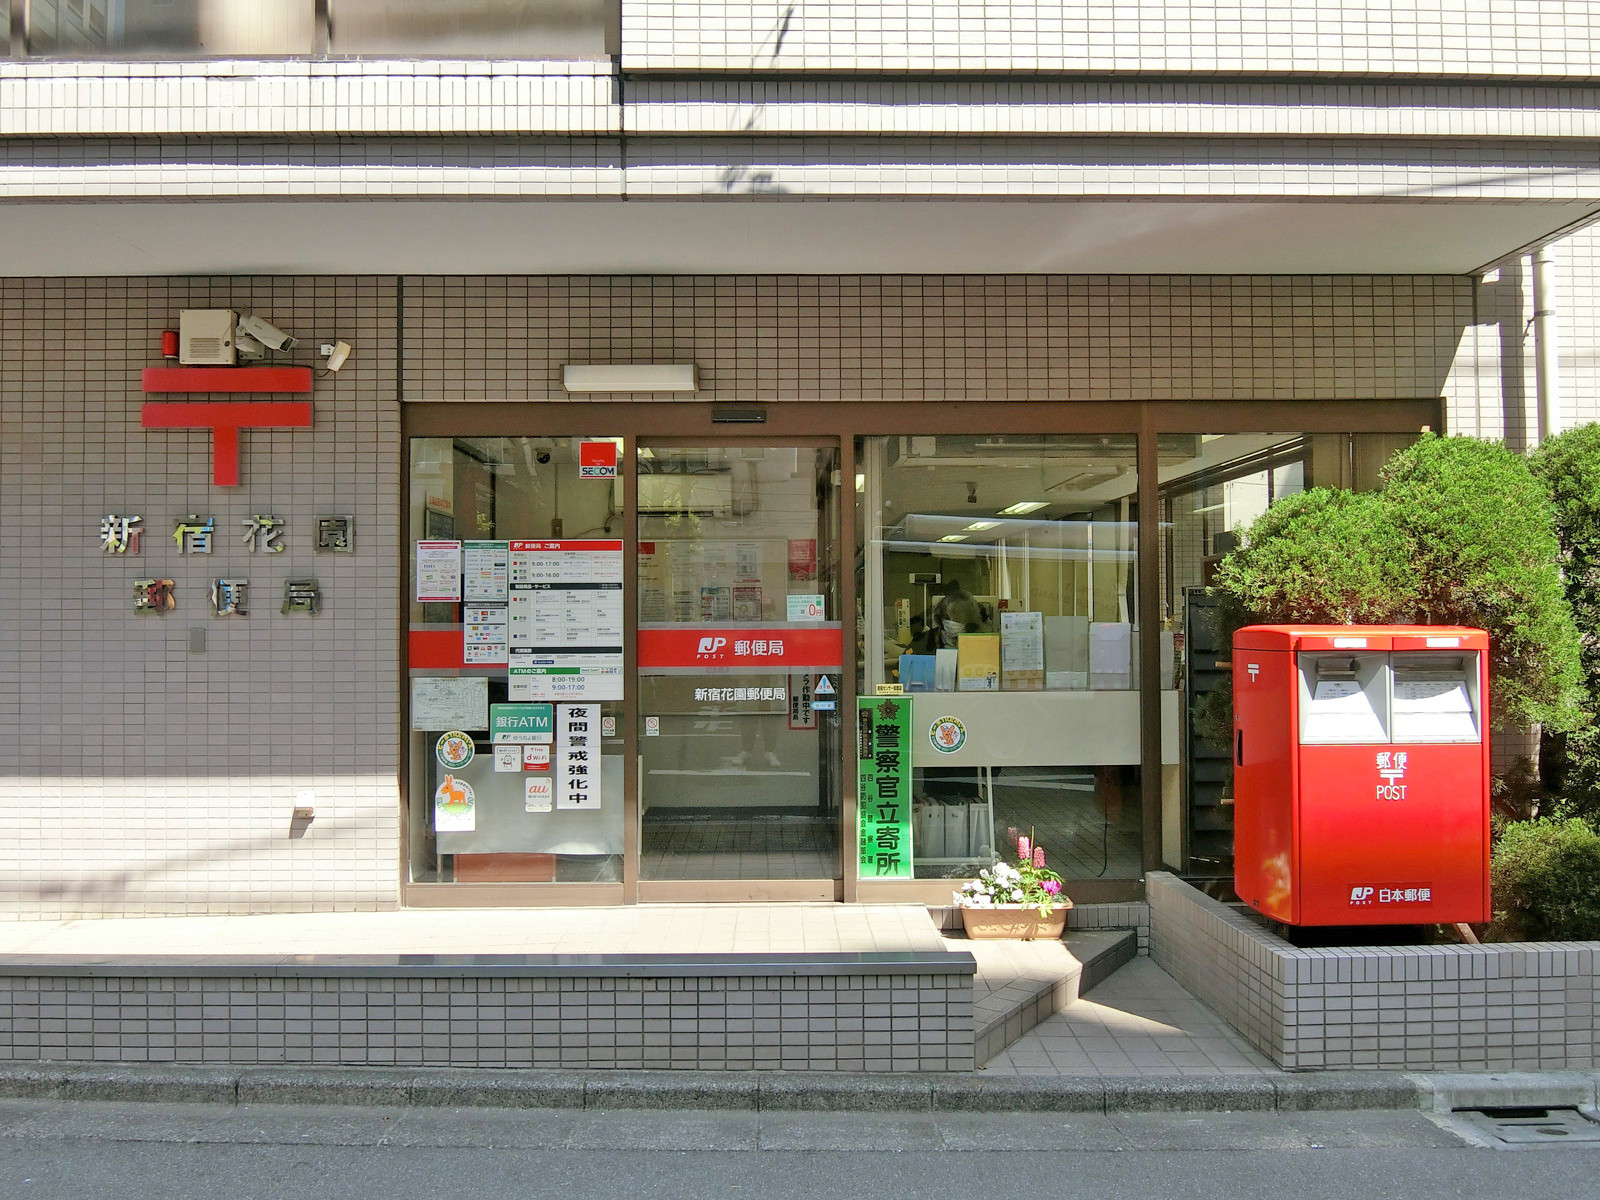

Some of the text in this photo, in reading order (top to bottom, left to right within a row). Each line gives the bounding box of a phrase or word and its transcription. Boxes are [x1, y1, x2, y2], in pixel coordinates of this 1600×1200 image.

[582, 467, 614, 475] SECOM
[100, 513, 354, 554] 新宿花園
[133, 578, 322, 617] 郵便局
[697, 637, 784, 656] JP 郵便局
[694, 687, 786, 701] 新宿花園郵便局
[496, 716, 548, 728] 銀行ATM
[568, 707, 589, 804] 夜間警戒強化中
[1376, 752, 1407, 770] 郵便
[529, 784, 549, 794] au
[1376, 785, 1407, 800] POST
[875, 724, 901, 876] 警察官立寄所
[1351, 887, 1431, 902] JP 日本郵便
